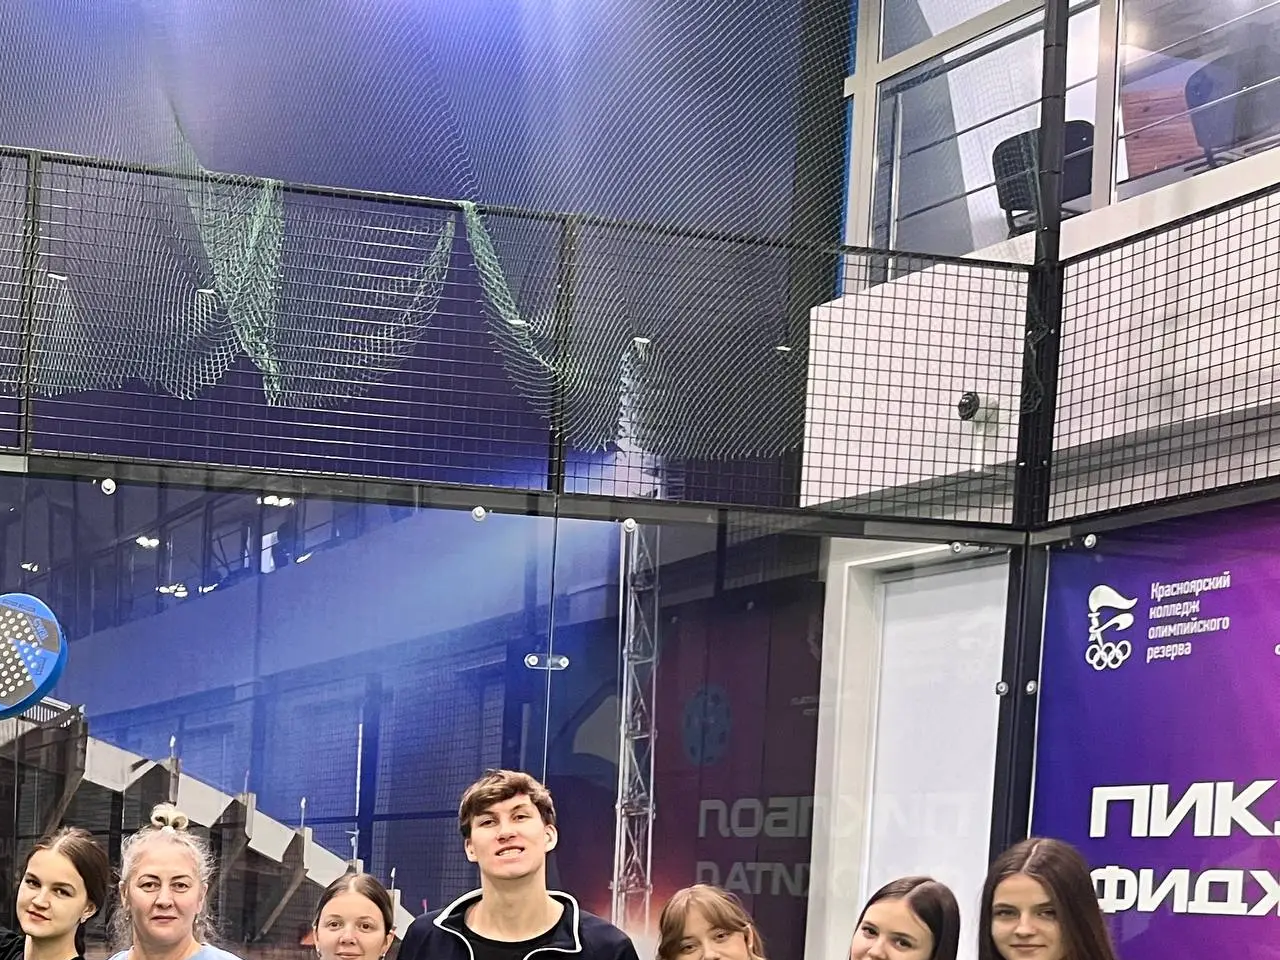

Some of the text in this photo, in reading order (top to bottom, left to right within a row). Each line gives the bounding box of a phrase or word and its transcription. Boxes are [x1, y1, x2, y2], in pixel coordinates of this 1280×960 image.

[1151, 571, 1231, 601] Красноярский
[1149, 600, 1200, 619] колледж
[1148, 616, 1230, 639] олимпийского
[1147, 641, 1192, 663] резерва
[1089, 780, 1280, 837] ПИК
